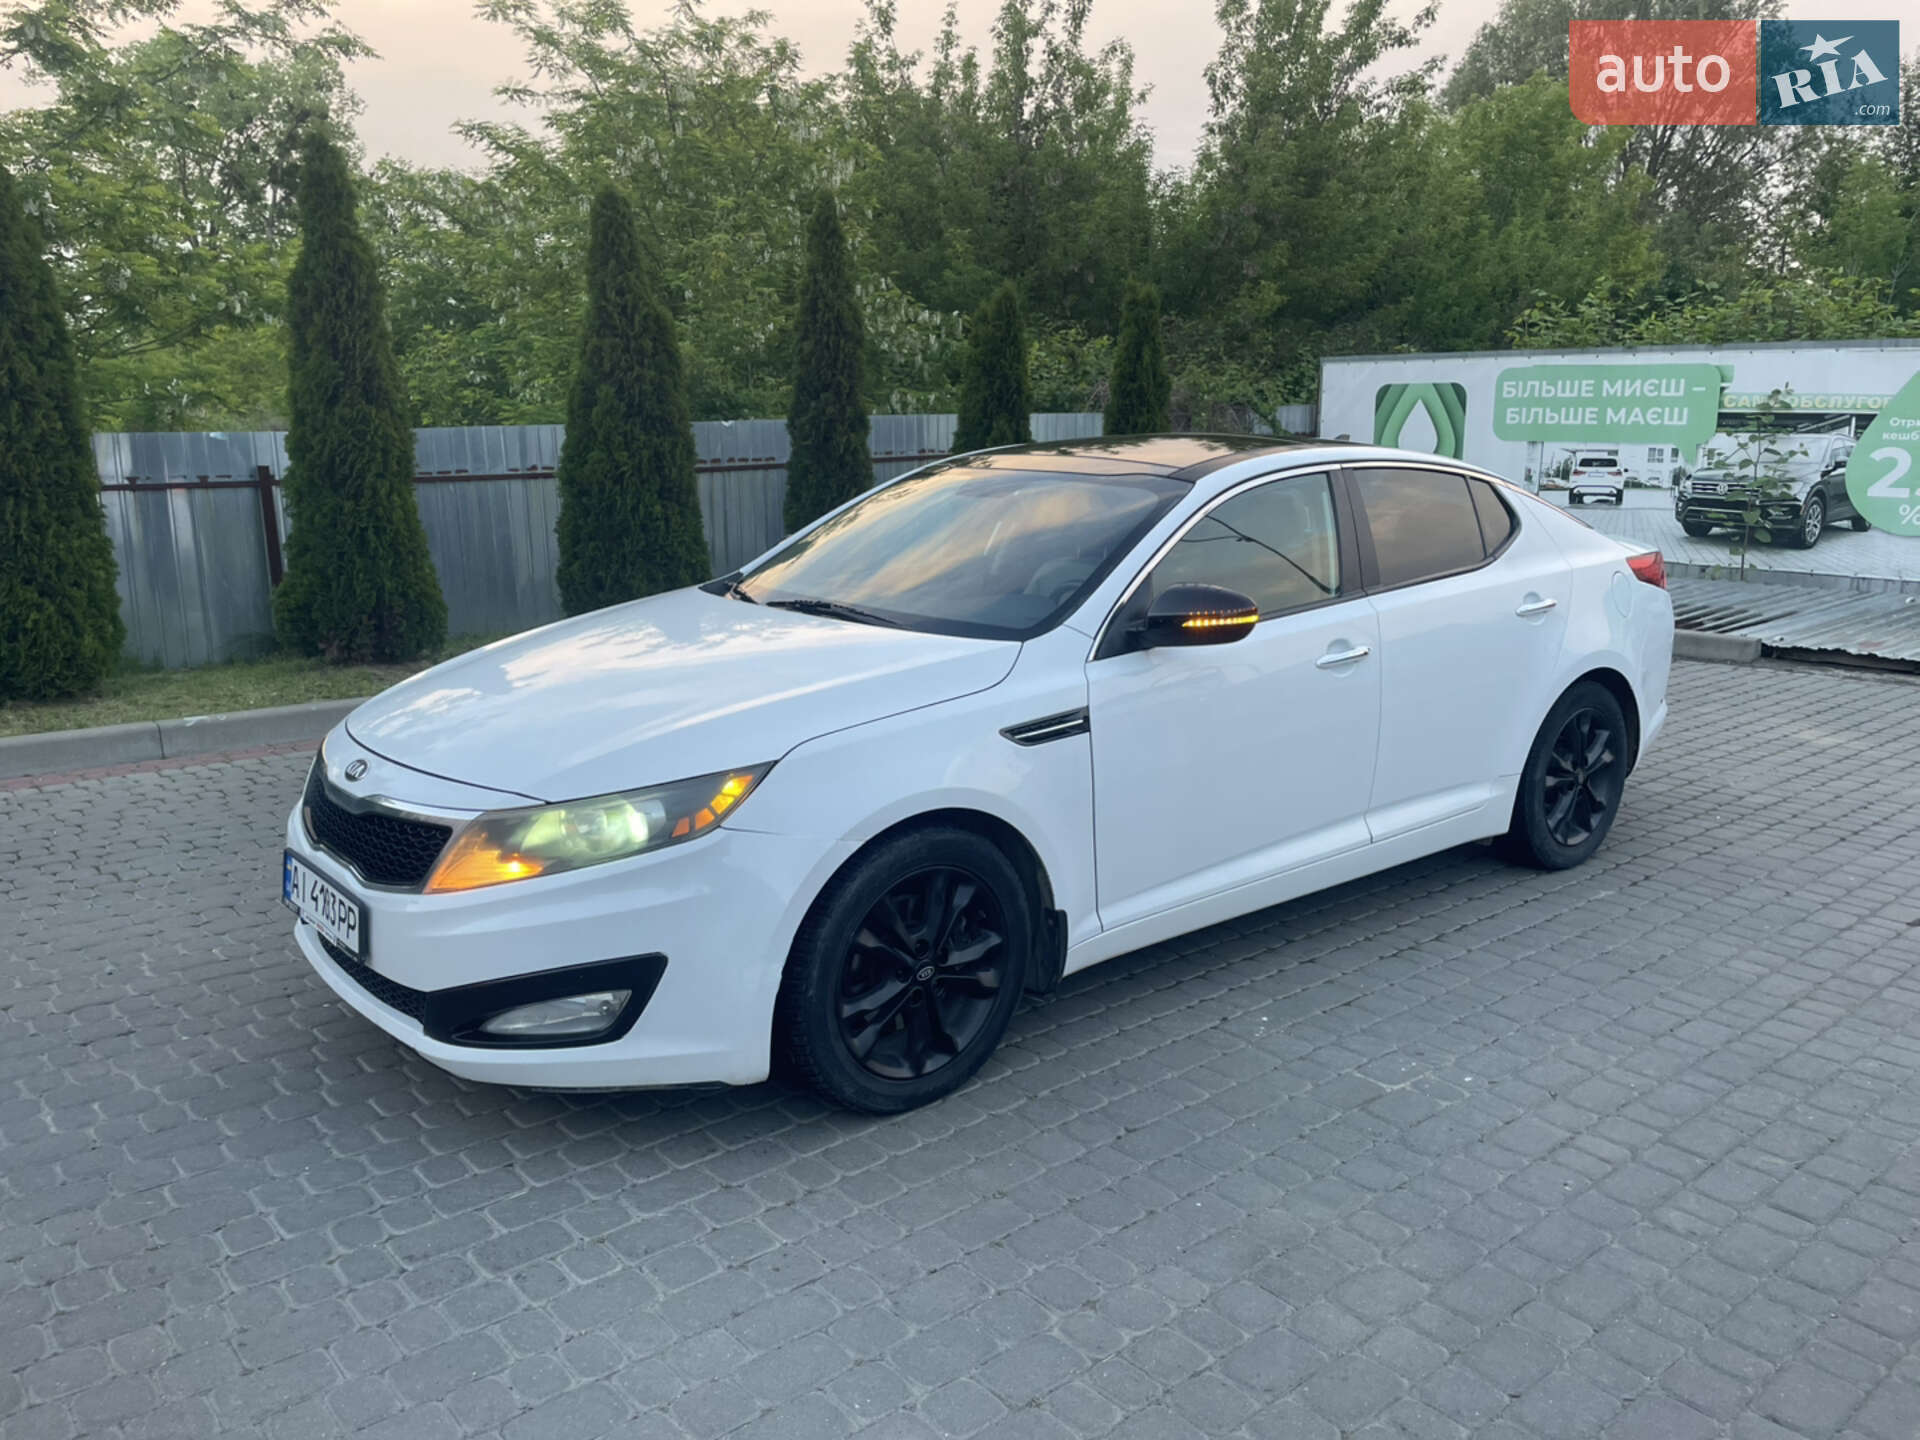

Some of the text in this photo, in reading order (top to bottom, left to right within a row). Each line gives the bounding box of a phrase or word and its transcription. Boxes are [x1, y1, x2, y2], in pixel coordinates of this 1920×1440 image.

[1502, 379, 1595, 398] БІЛЬШЕ
[1602, 378, 1686, 398] МИЄШ
[1505, 406, 1689, 425] БІЛЬШЕ МАЄШ
